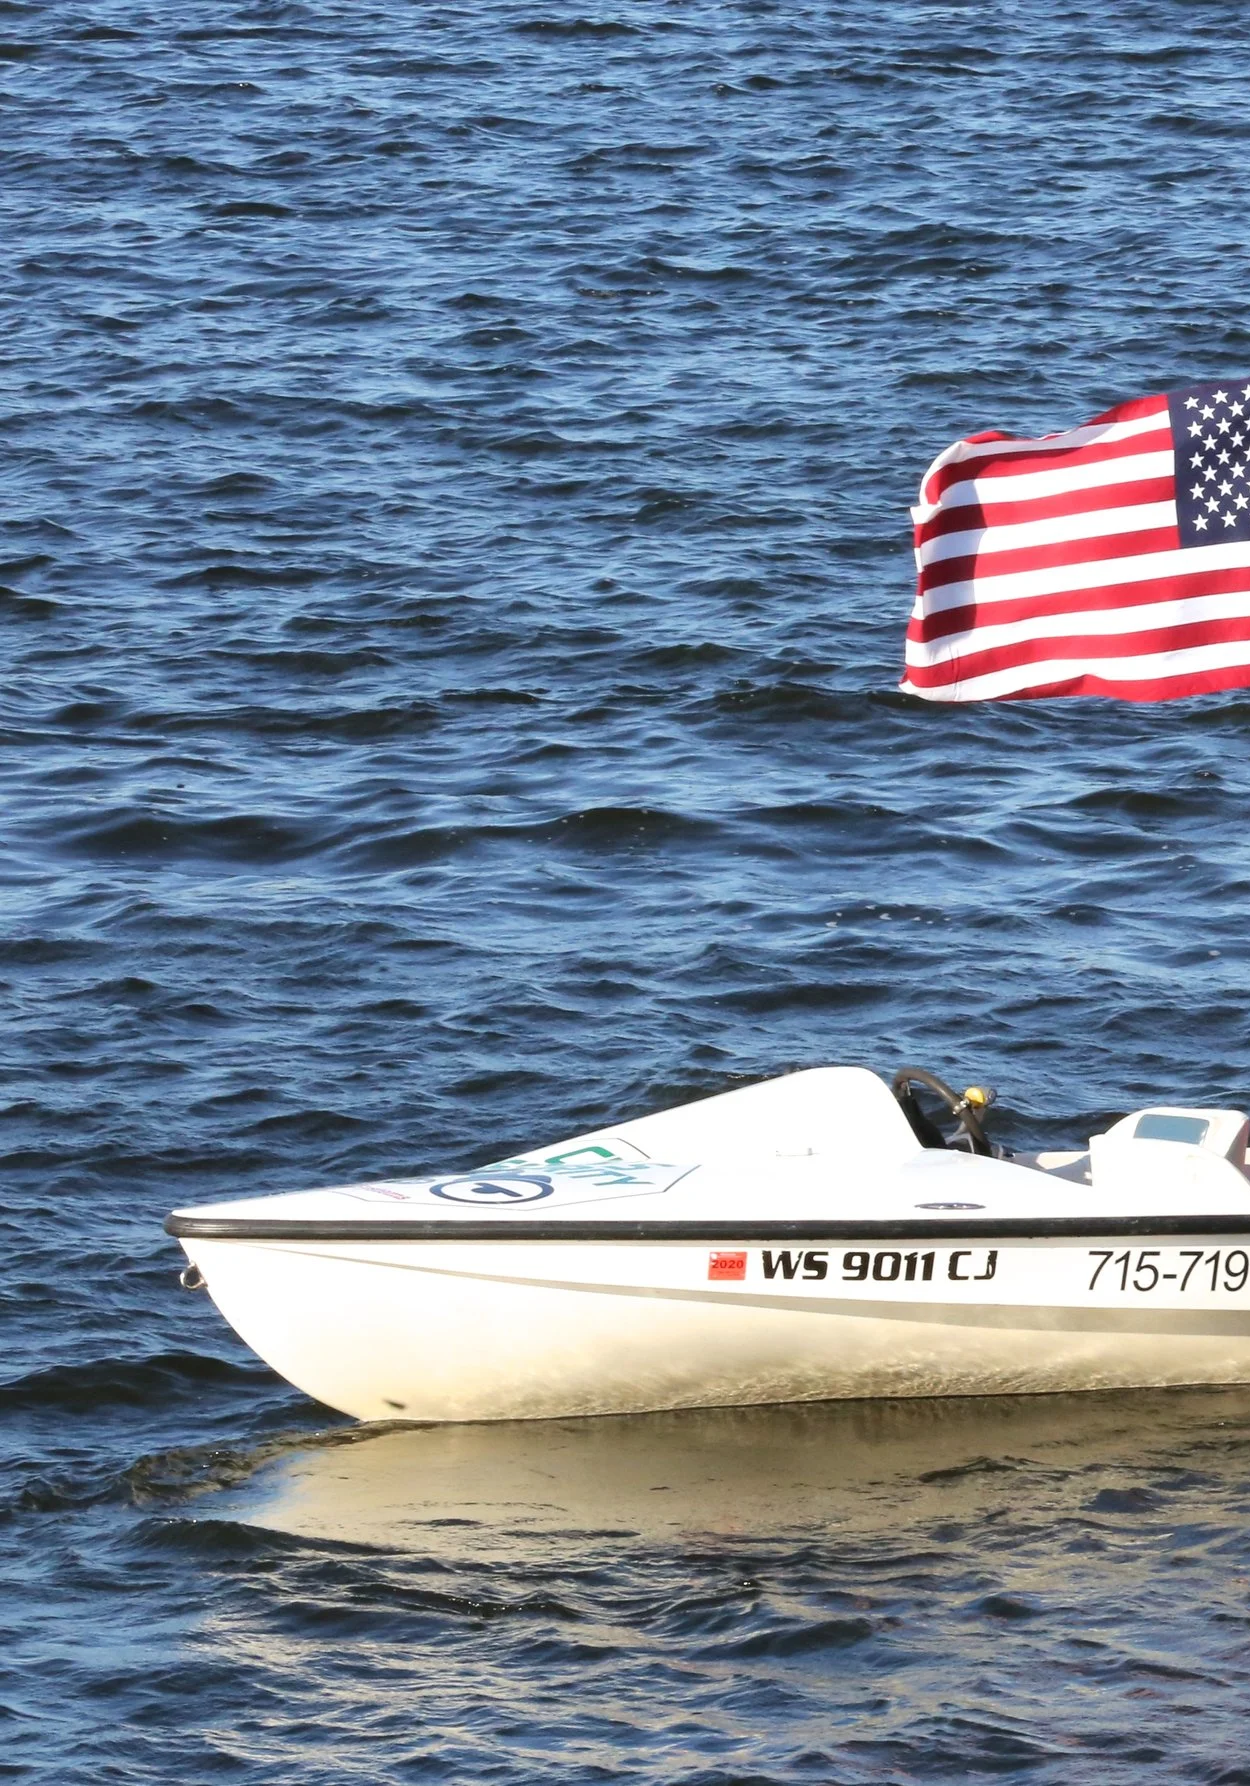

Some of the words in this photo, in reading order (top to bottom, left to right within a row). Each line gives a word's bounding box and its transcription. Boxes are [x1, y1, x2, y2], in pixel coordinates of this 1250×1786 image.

[711, 1259, 745, 1269] 2020
[762, 1250, 829, 1280] WS
[842, 1251, 936, 1281] 9011
[948, 1250, 998, 1281] CJ
